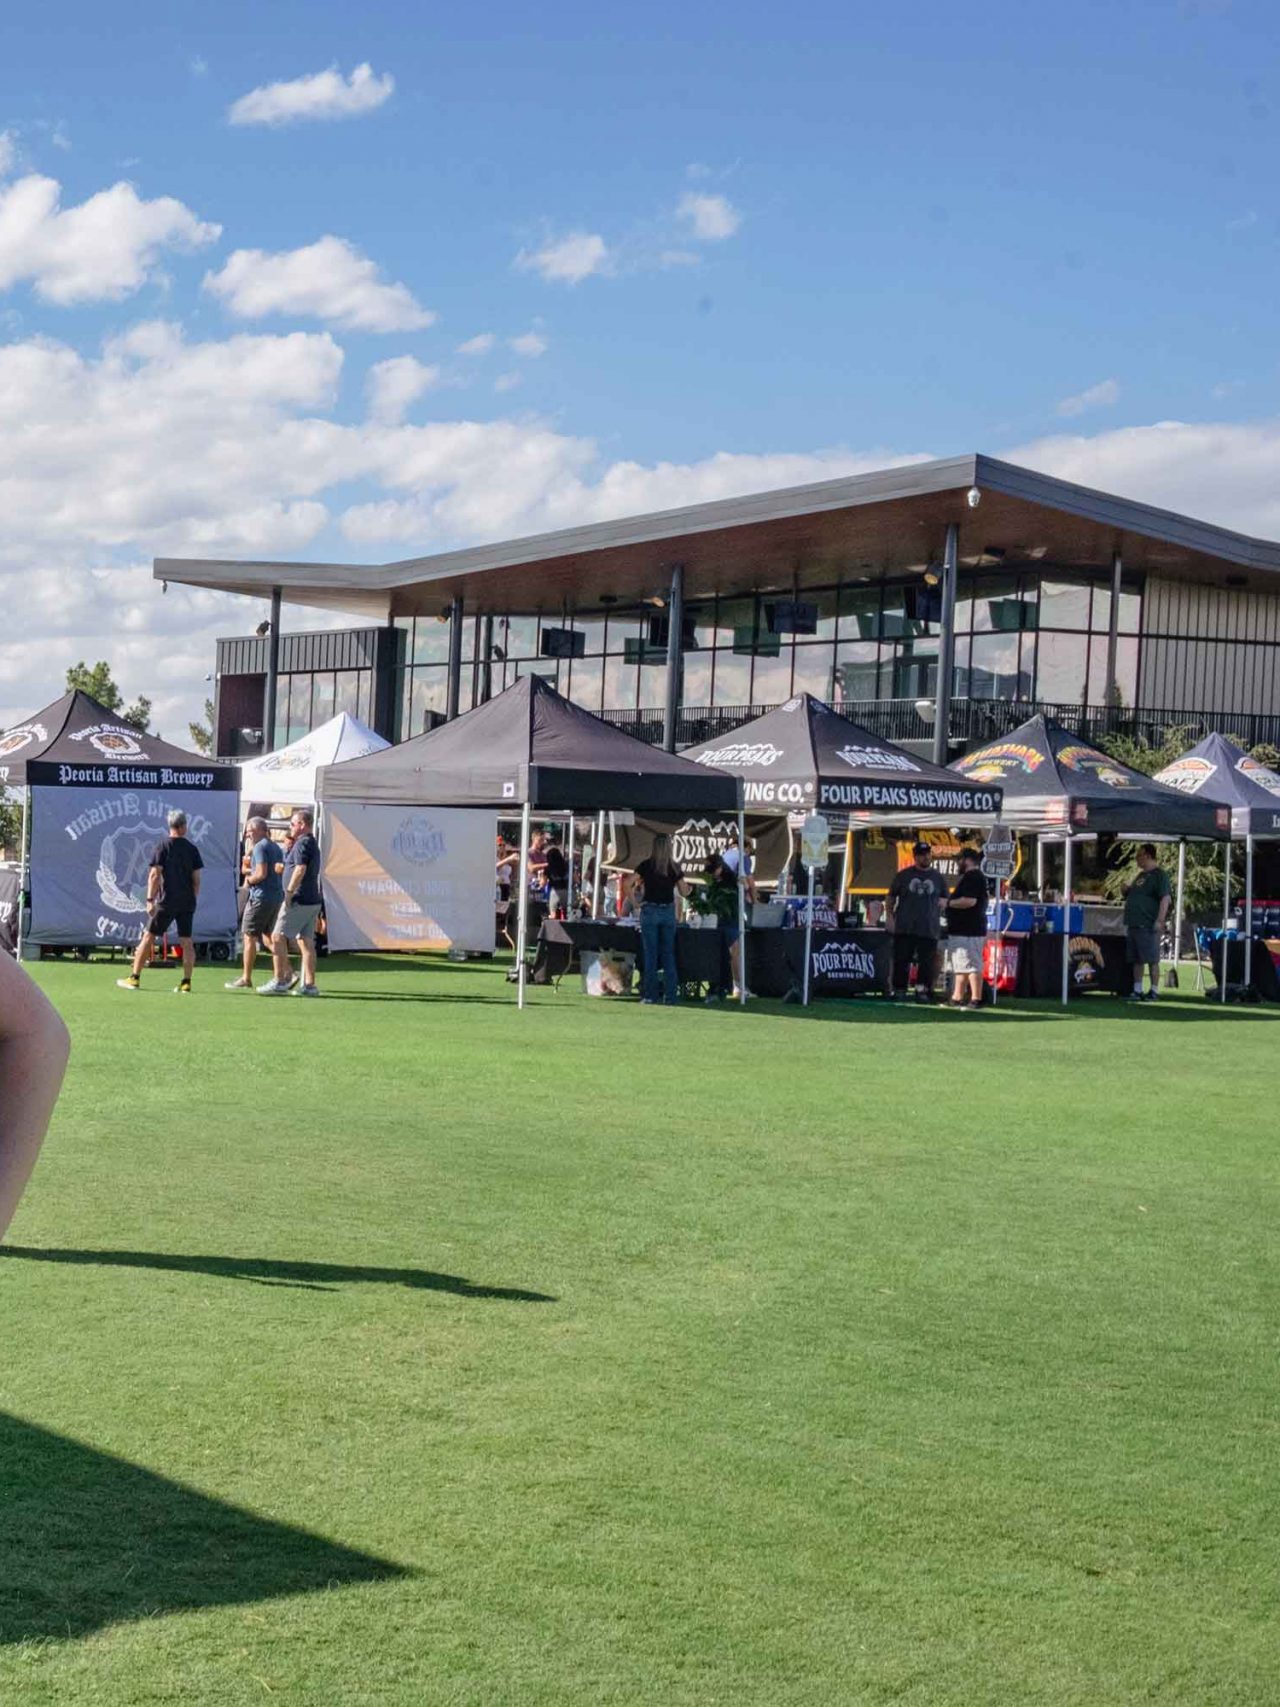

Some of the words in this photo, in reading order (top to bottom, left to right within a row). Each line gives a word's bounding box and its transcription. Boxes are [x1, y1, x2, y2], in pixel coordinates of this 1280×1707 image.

[58, 765, 104, 784] Peoria
[107, 767, 158, 784] Artisan
[160, 768, 214, 788] Brewery
[821, 785, 862, 804] FOUR
[864, 786, 908, 806] PEAKS
[911, 788, 971, 810] BREWING
[673, 834, 707, 863] OUR
[812, 953, 841, 978] FOUR
[841, 951, 874, 978] PEAKS
